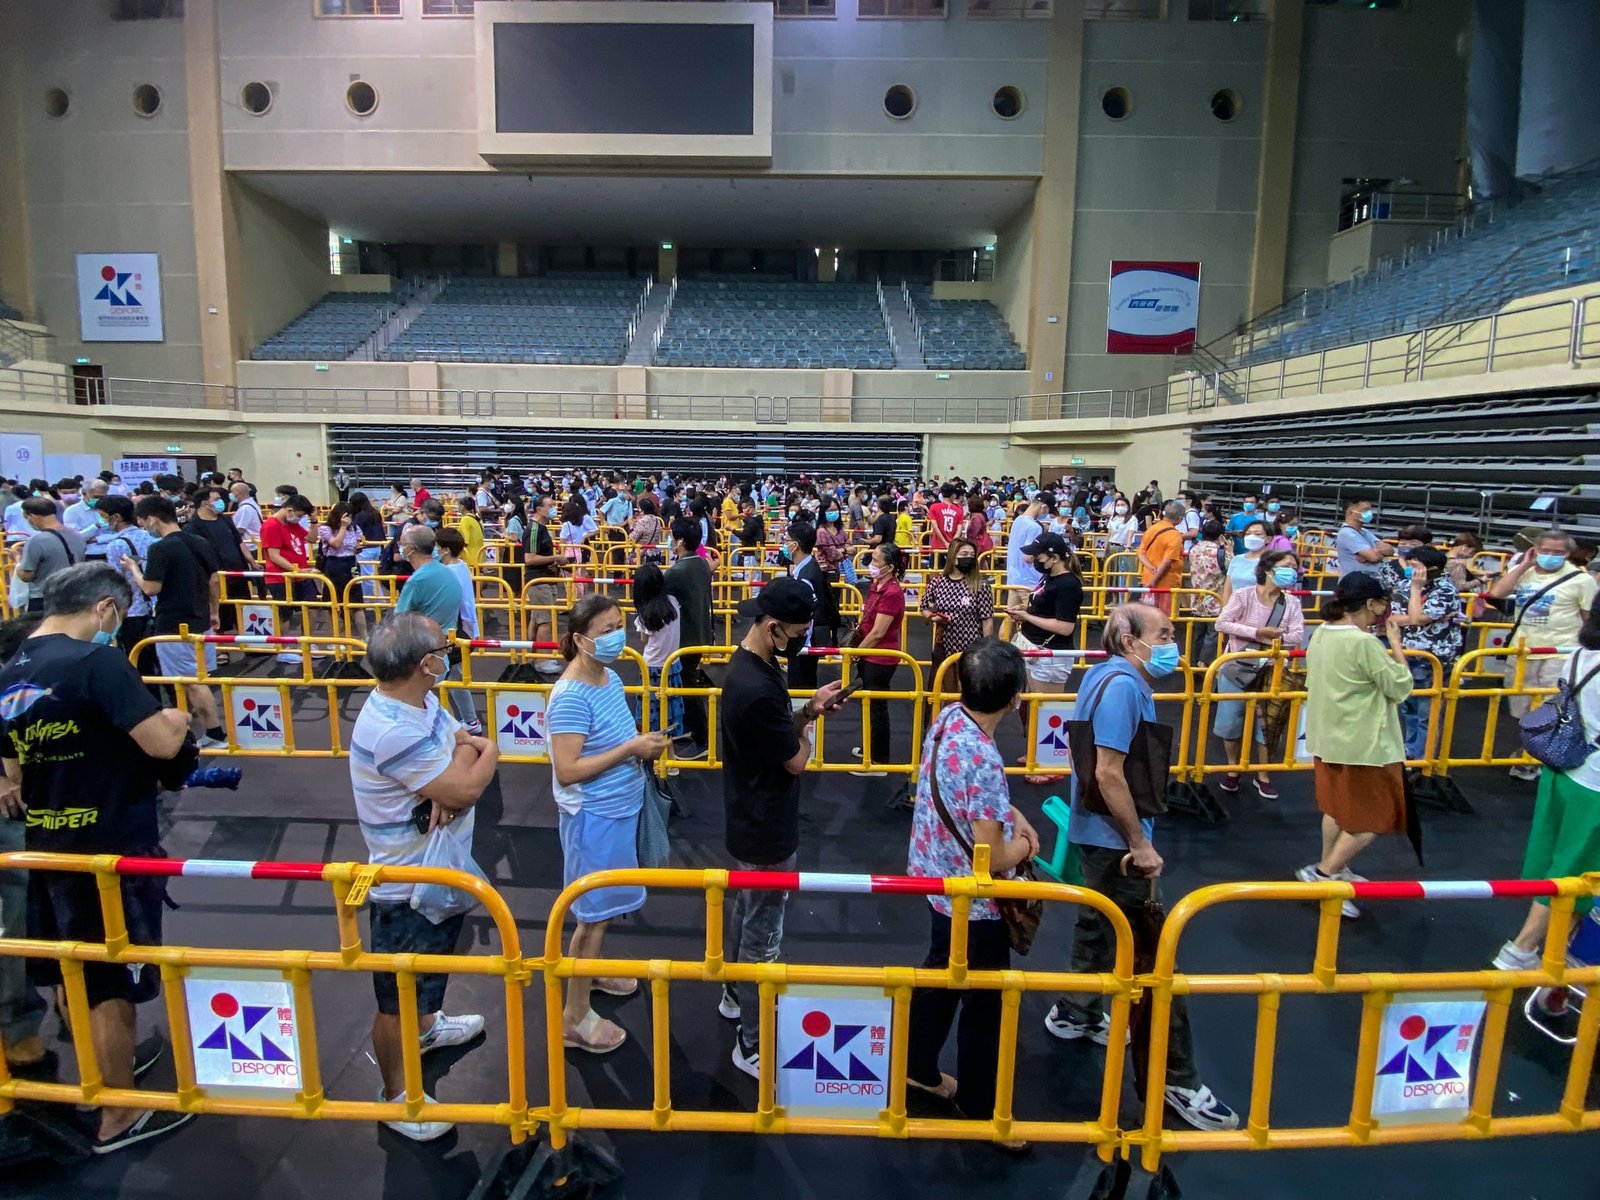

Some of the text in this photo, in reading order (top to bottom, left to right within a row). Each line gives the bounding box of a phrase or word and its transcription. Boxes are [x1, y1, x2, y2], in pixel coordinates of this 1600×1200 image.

[120, 461, 169, 472] 核酸檢測處
[943, 516, 954, 532] 13
[870, 1025, 886, 1056] 體育
[815, 1082, 884, 1096] DESPORTO
